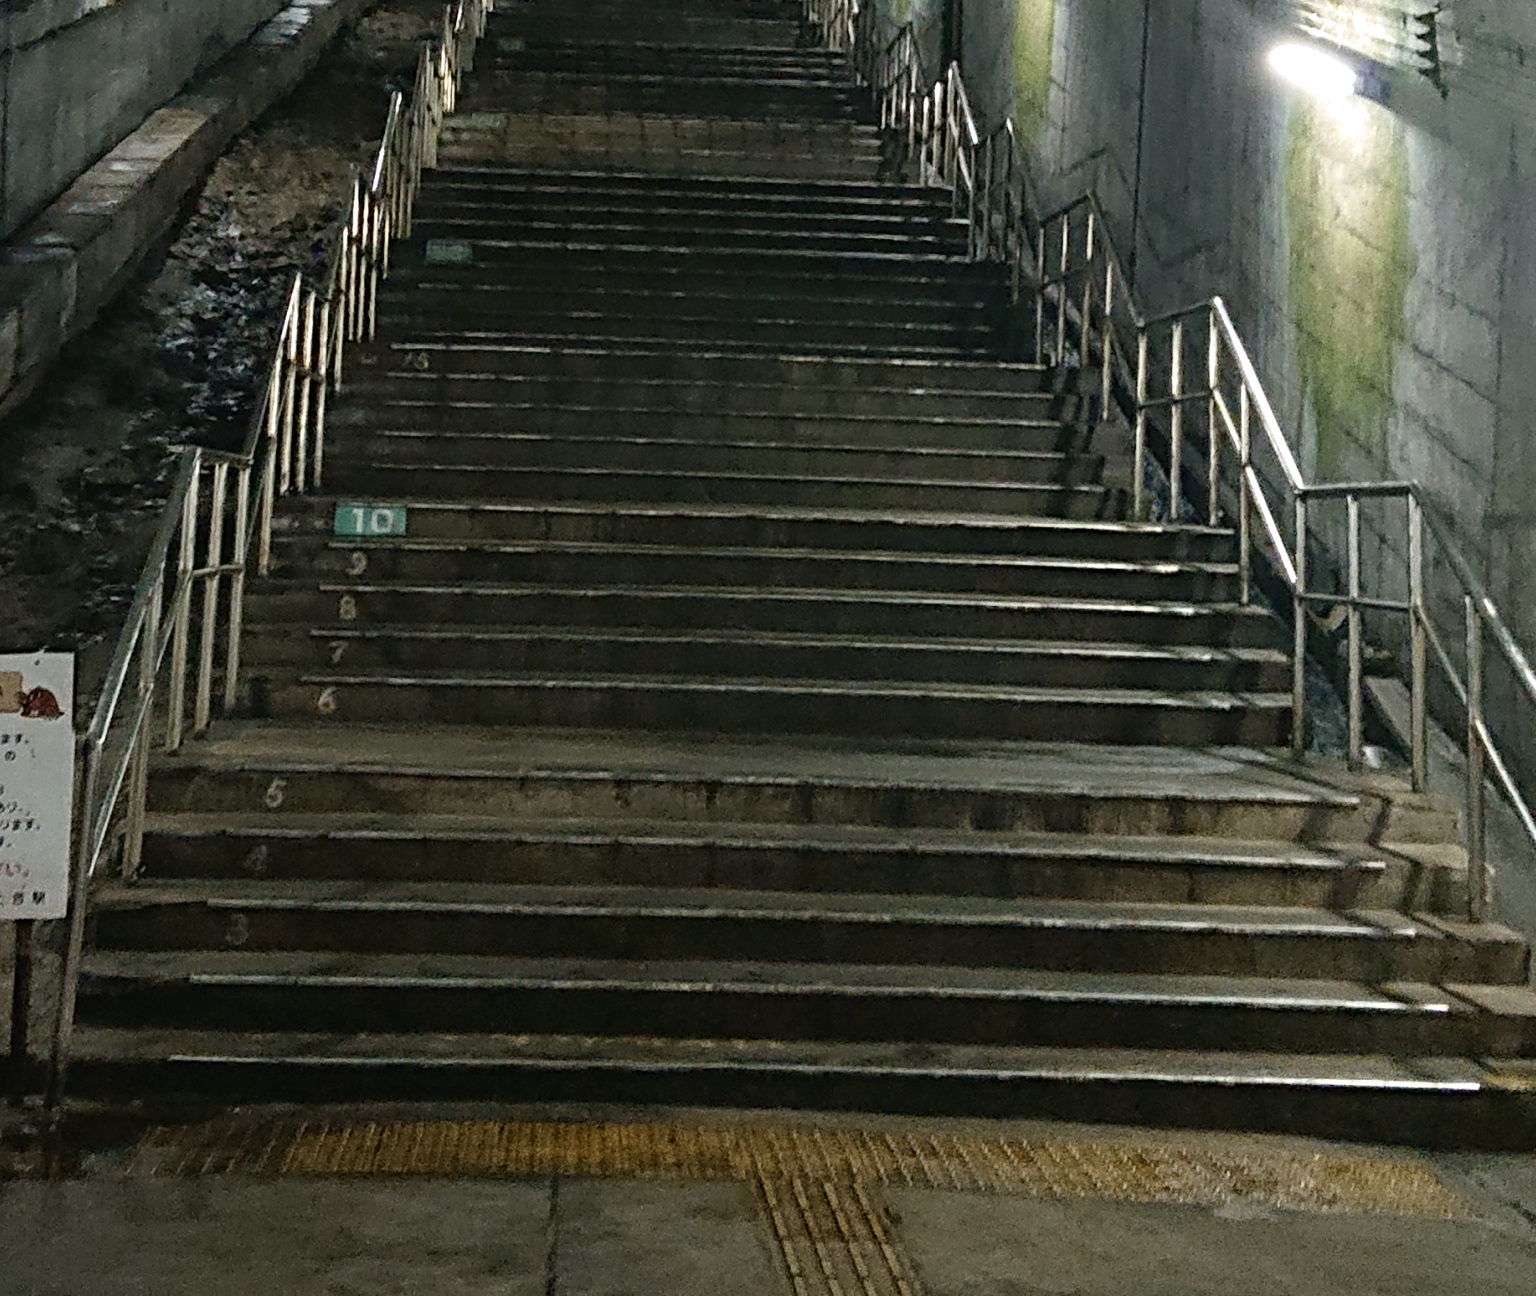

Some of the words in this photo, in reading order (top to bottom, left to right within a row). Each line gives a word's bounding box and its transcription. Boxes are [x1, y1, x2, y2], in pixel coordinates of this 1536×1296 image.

[351, 507, 394, 535] 10
[338, 595, 357, 620] 8
[329, 641, 350, 664] 7
[318, 687, 339, 714] 6
[266, 777, 288, 808] 5
